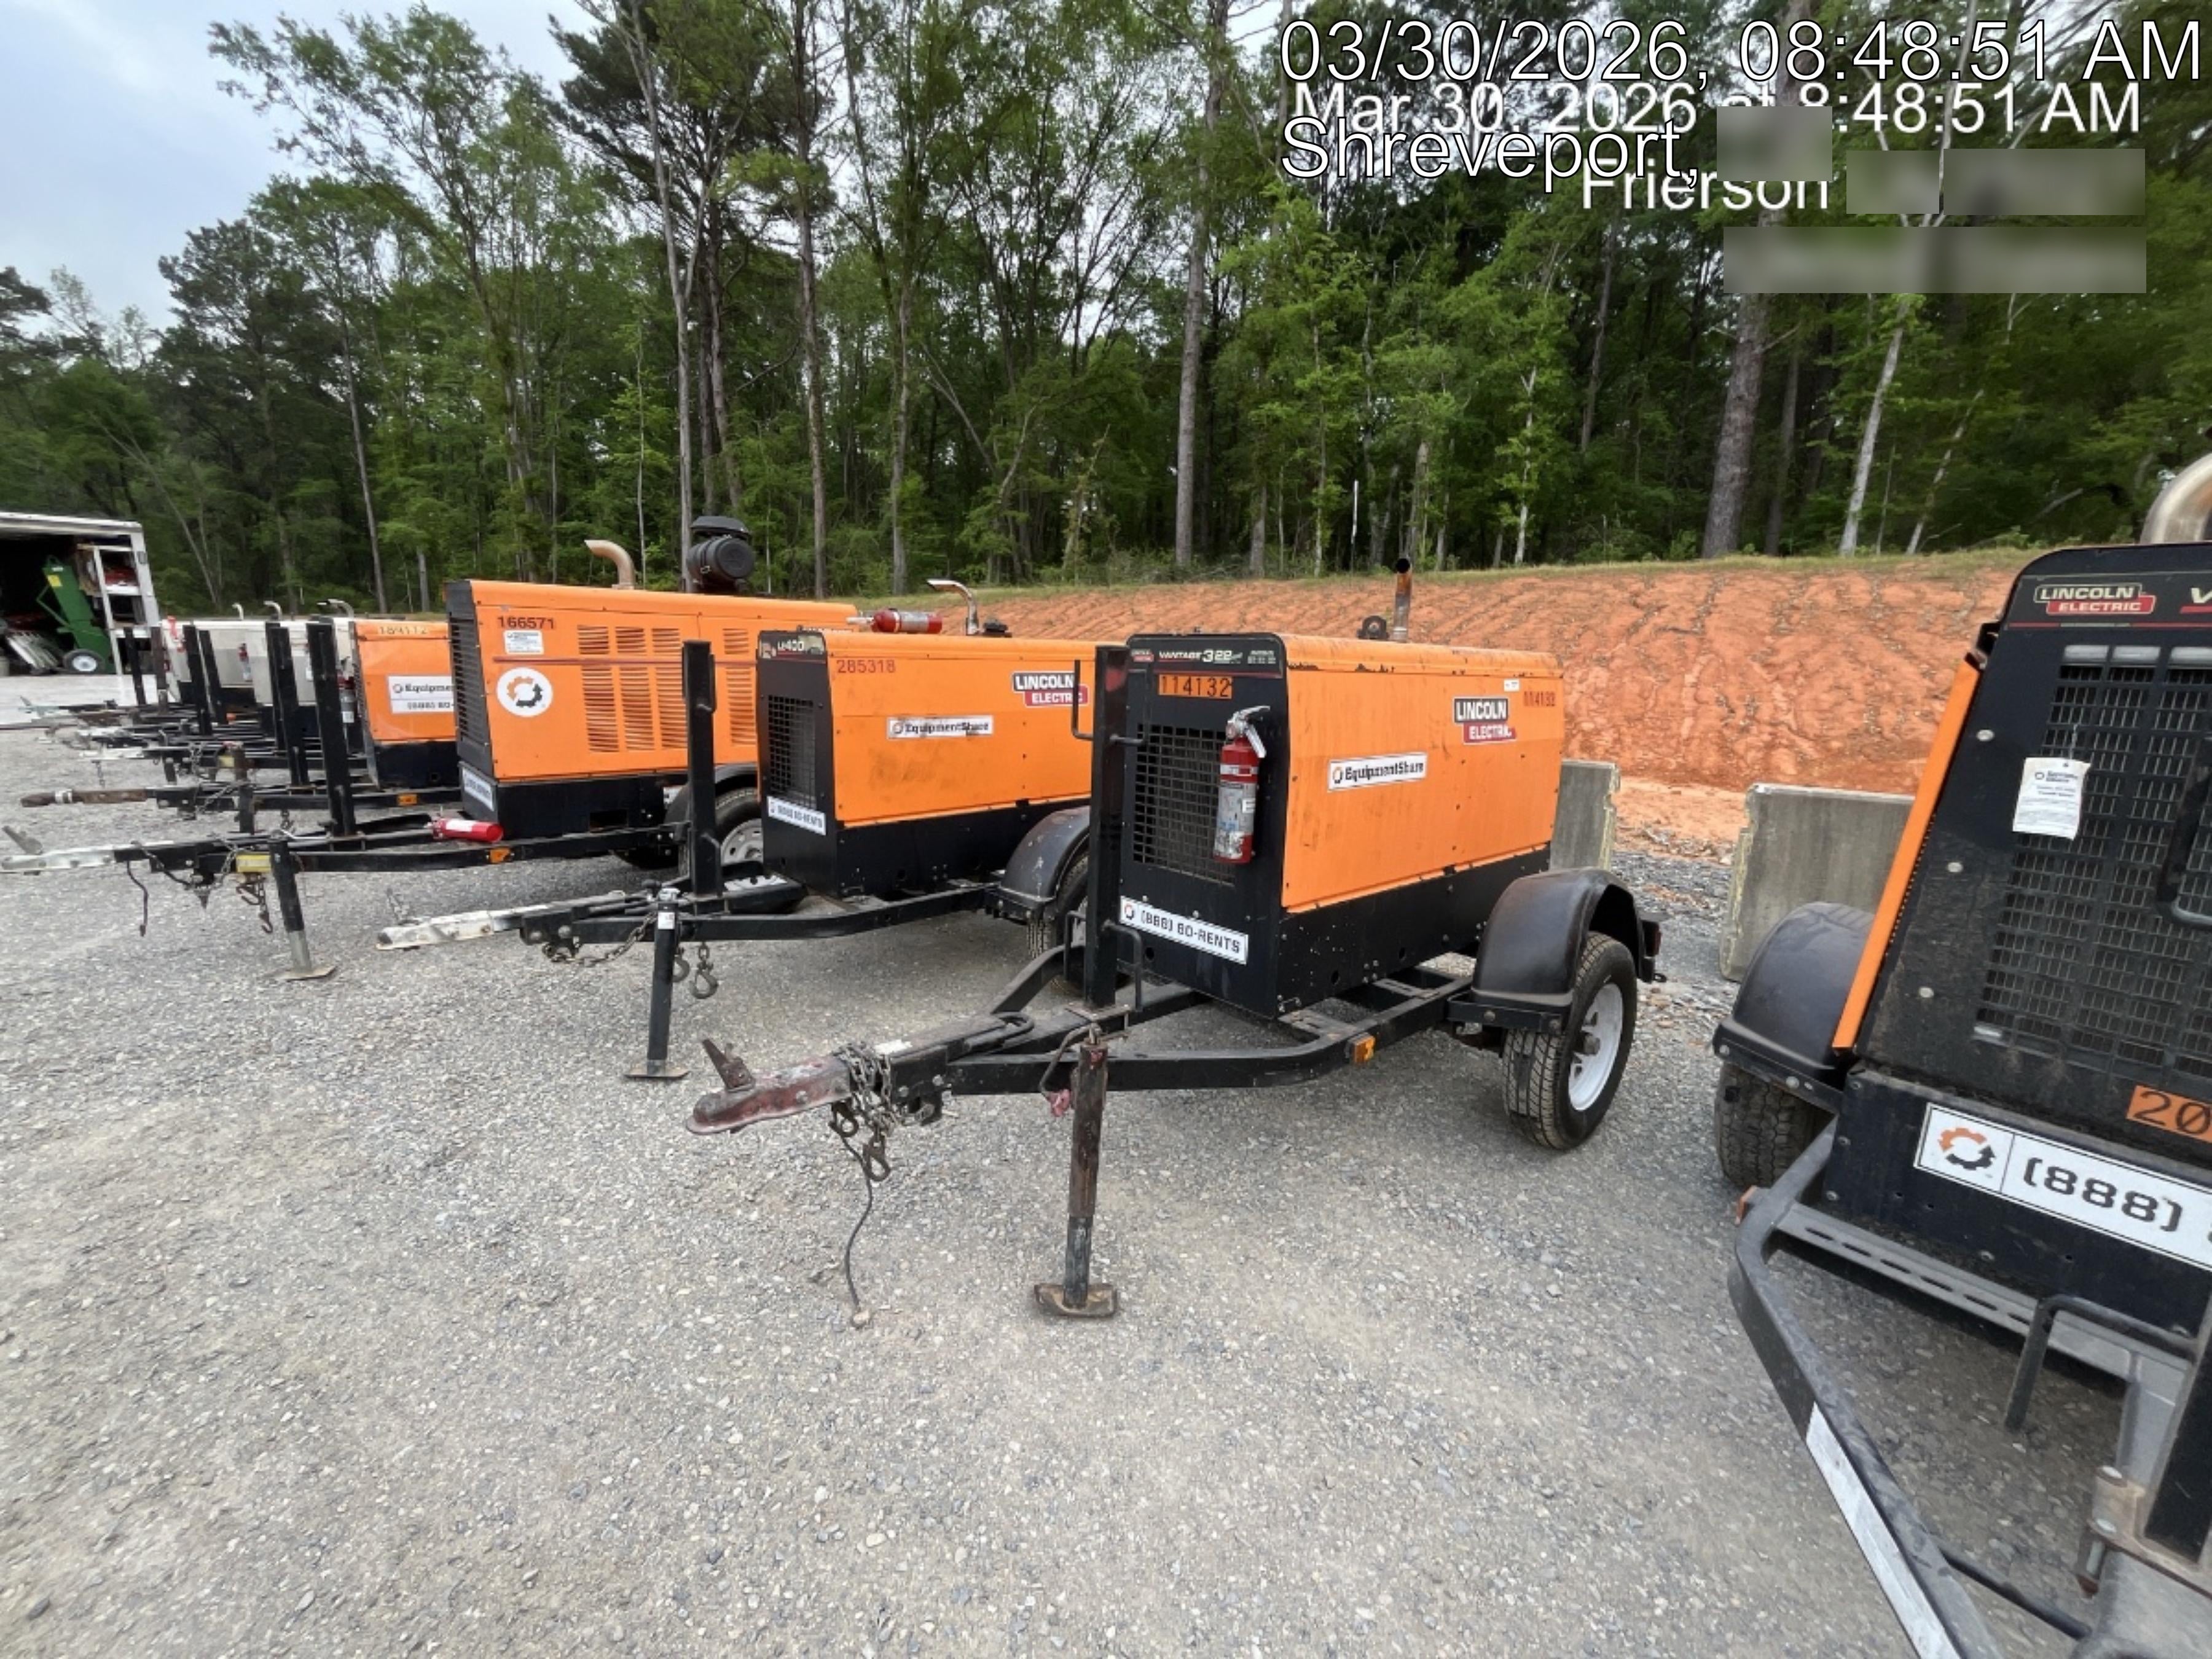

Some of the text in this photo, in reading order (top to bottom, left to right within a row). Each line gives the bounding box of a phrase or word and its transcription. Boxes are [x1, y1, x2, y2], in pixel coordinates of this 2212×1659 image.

[2040, 587, 2135, 600] LINCOLN
[2058, 602, 2143, 612] ELECTRIC
[497, 616, 555, 630] 166571
[836, 659, 896, 674] 285318
[1015, 675, 1074, 689] LINCOLN
[1162, 677, 1231, 697] 114132
[1032, 692, 1083, 704] ELECTRC
[1456, 700, 1507, 721] LINCOLN
[2023, 1157, 2183, 1232] (888)
